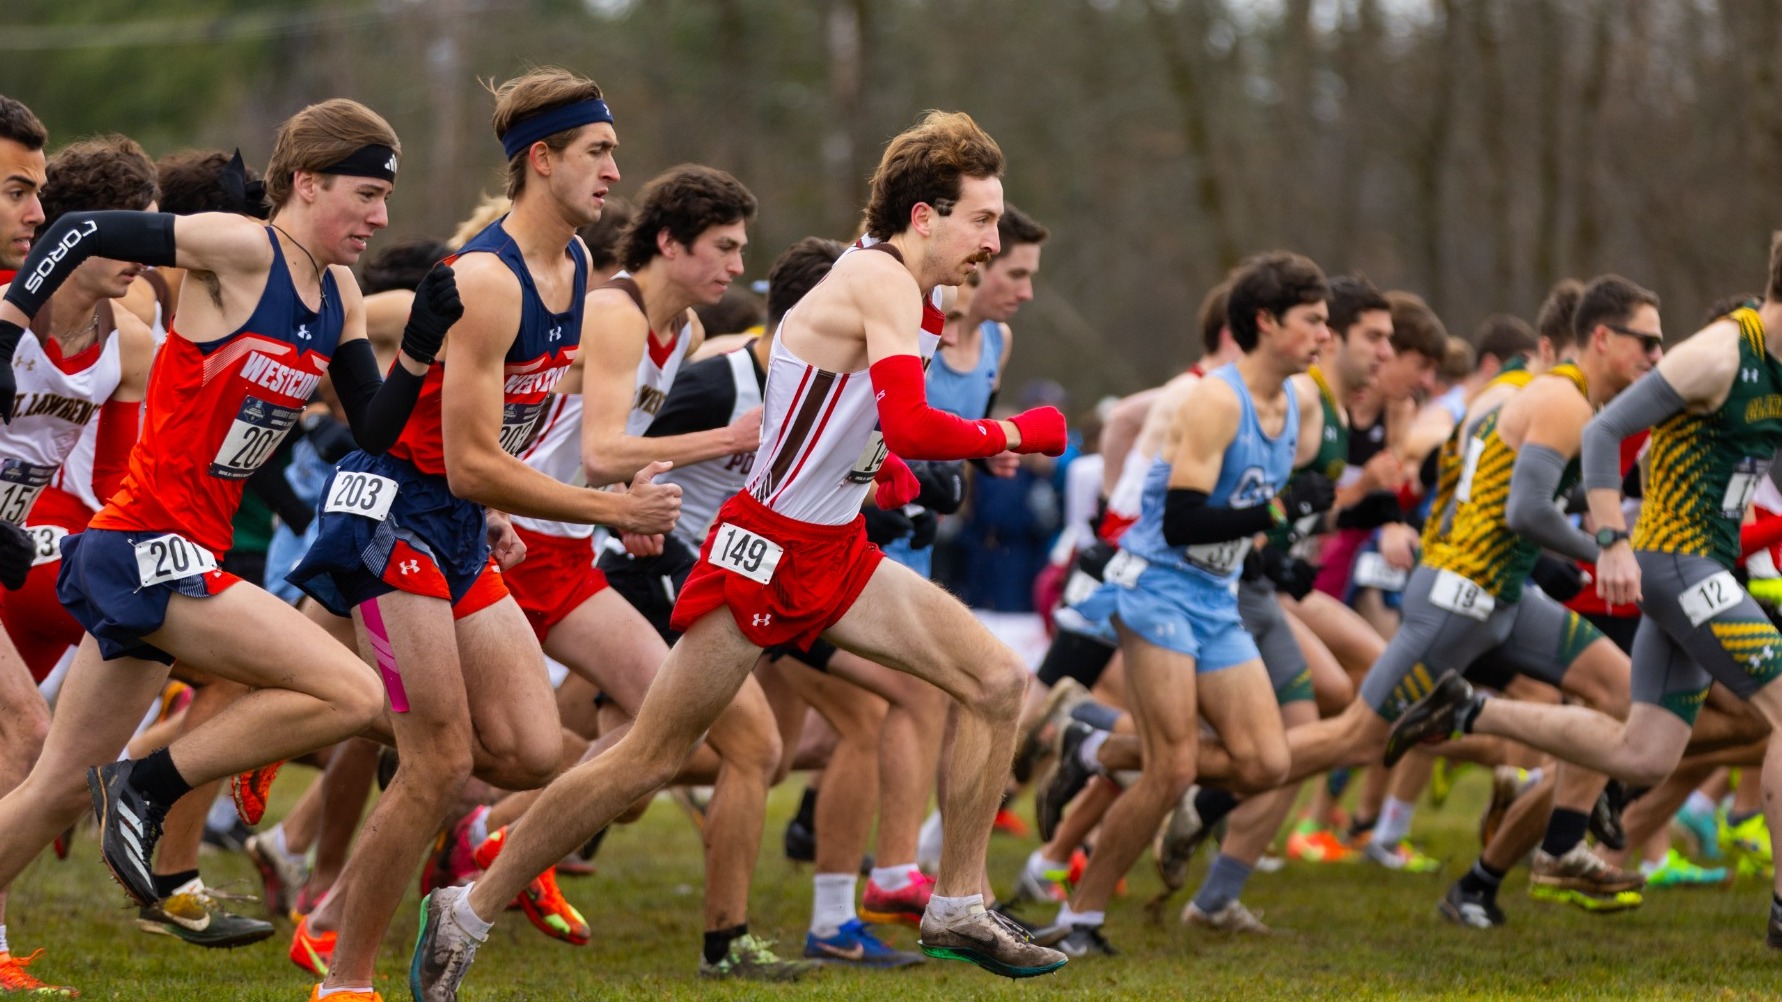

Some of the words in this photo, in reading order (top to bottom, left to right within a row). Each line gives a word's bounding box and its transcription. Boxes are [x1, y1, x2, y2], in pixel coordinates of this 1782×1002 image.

[25, 220, 97, 294] COROS
[228, 427, 284, 468] 201
[334, 474, 383, 510] 203
[722, 529, 768, 572] 149
[1699, 580, 1729, 609] 12
